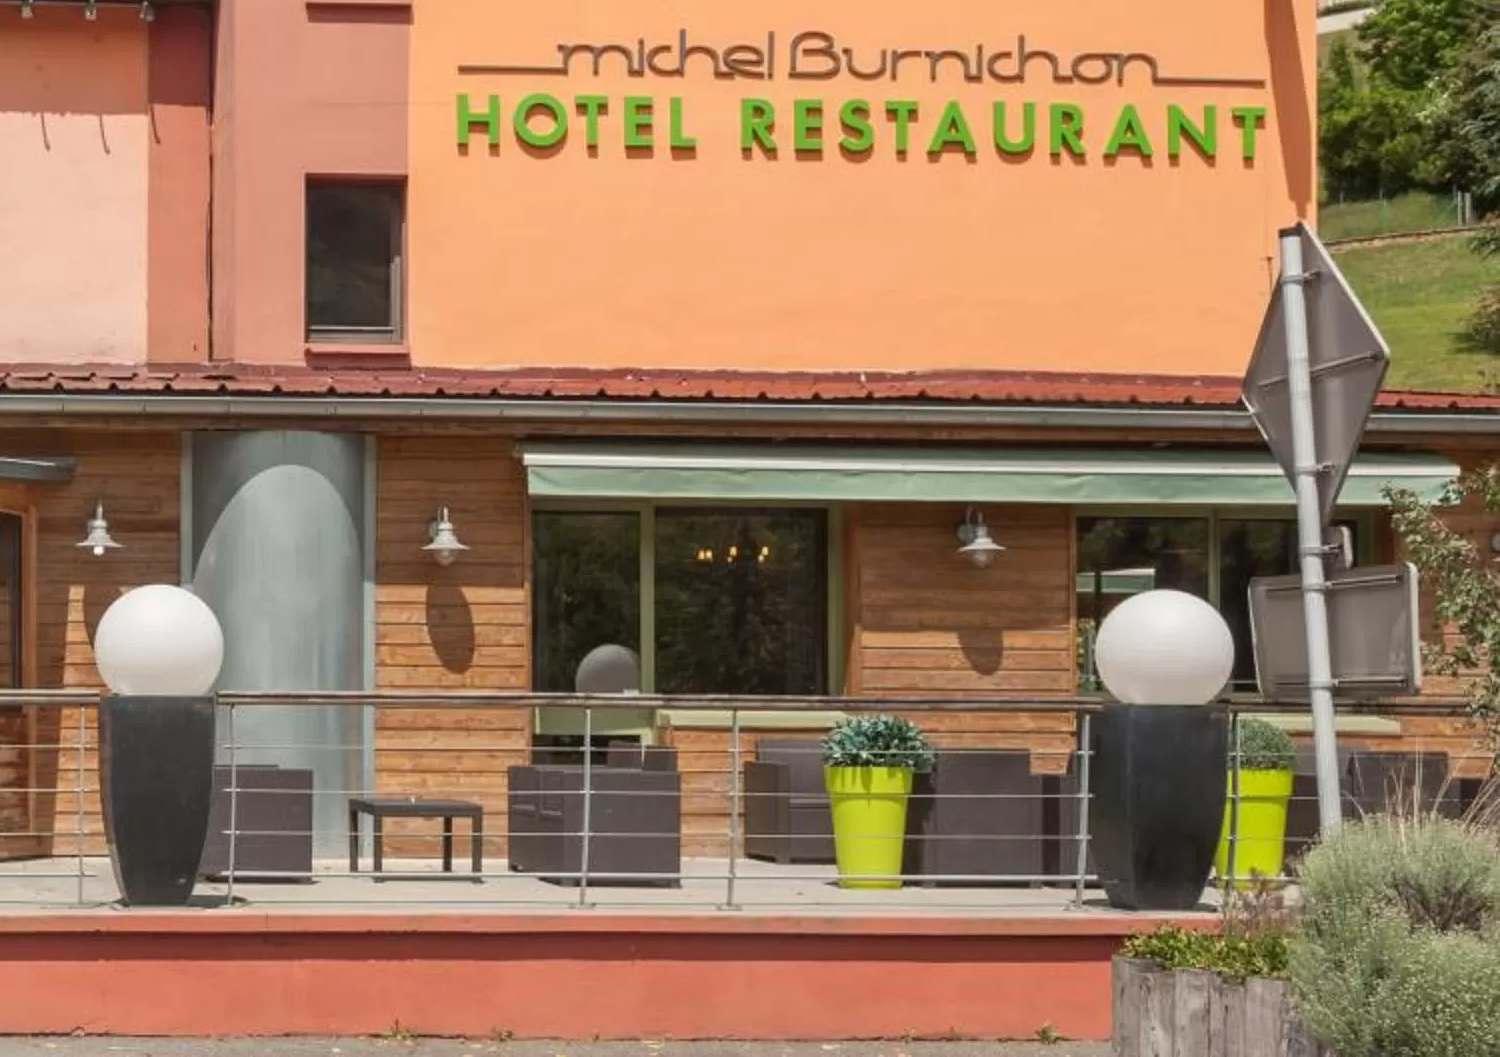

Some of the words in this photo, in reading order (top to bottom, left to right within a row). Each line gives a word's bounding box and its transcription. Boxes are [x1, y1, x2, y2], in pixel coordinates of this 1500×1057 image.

[556, 28, 775, 80] michel
[788, 30, 1160, 88] Burnichon
[456, 92, 698, 151] HOTEL
[740, 97, 1268, 163] RESTAURANT
